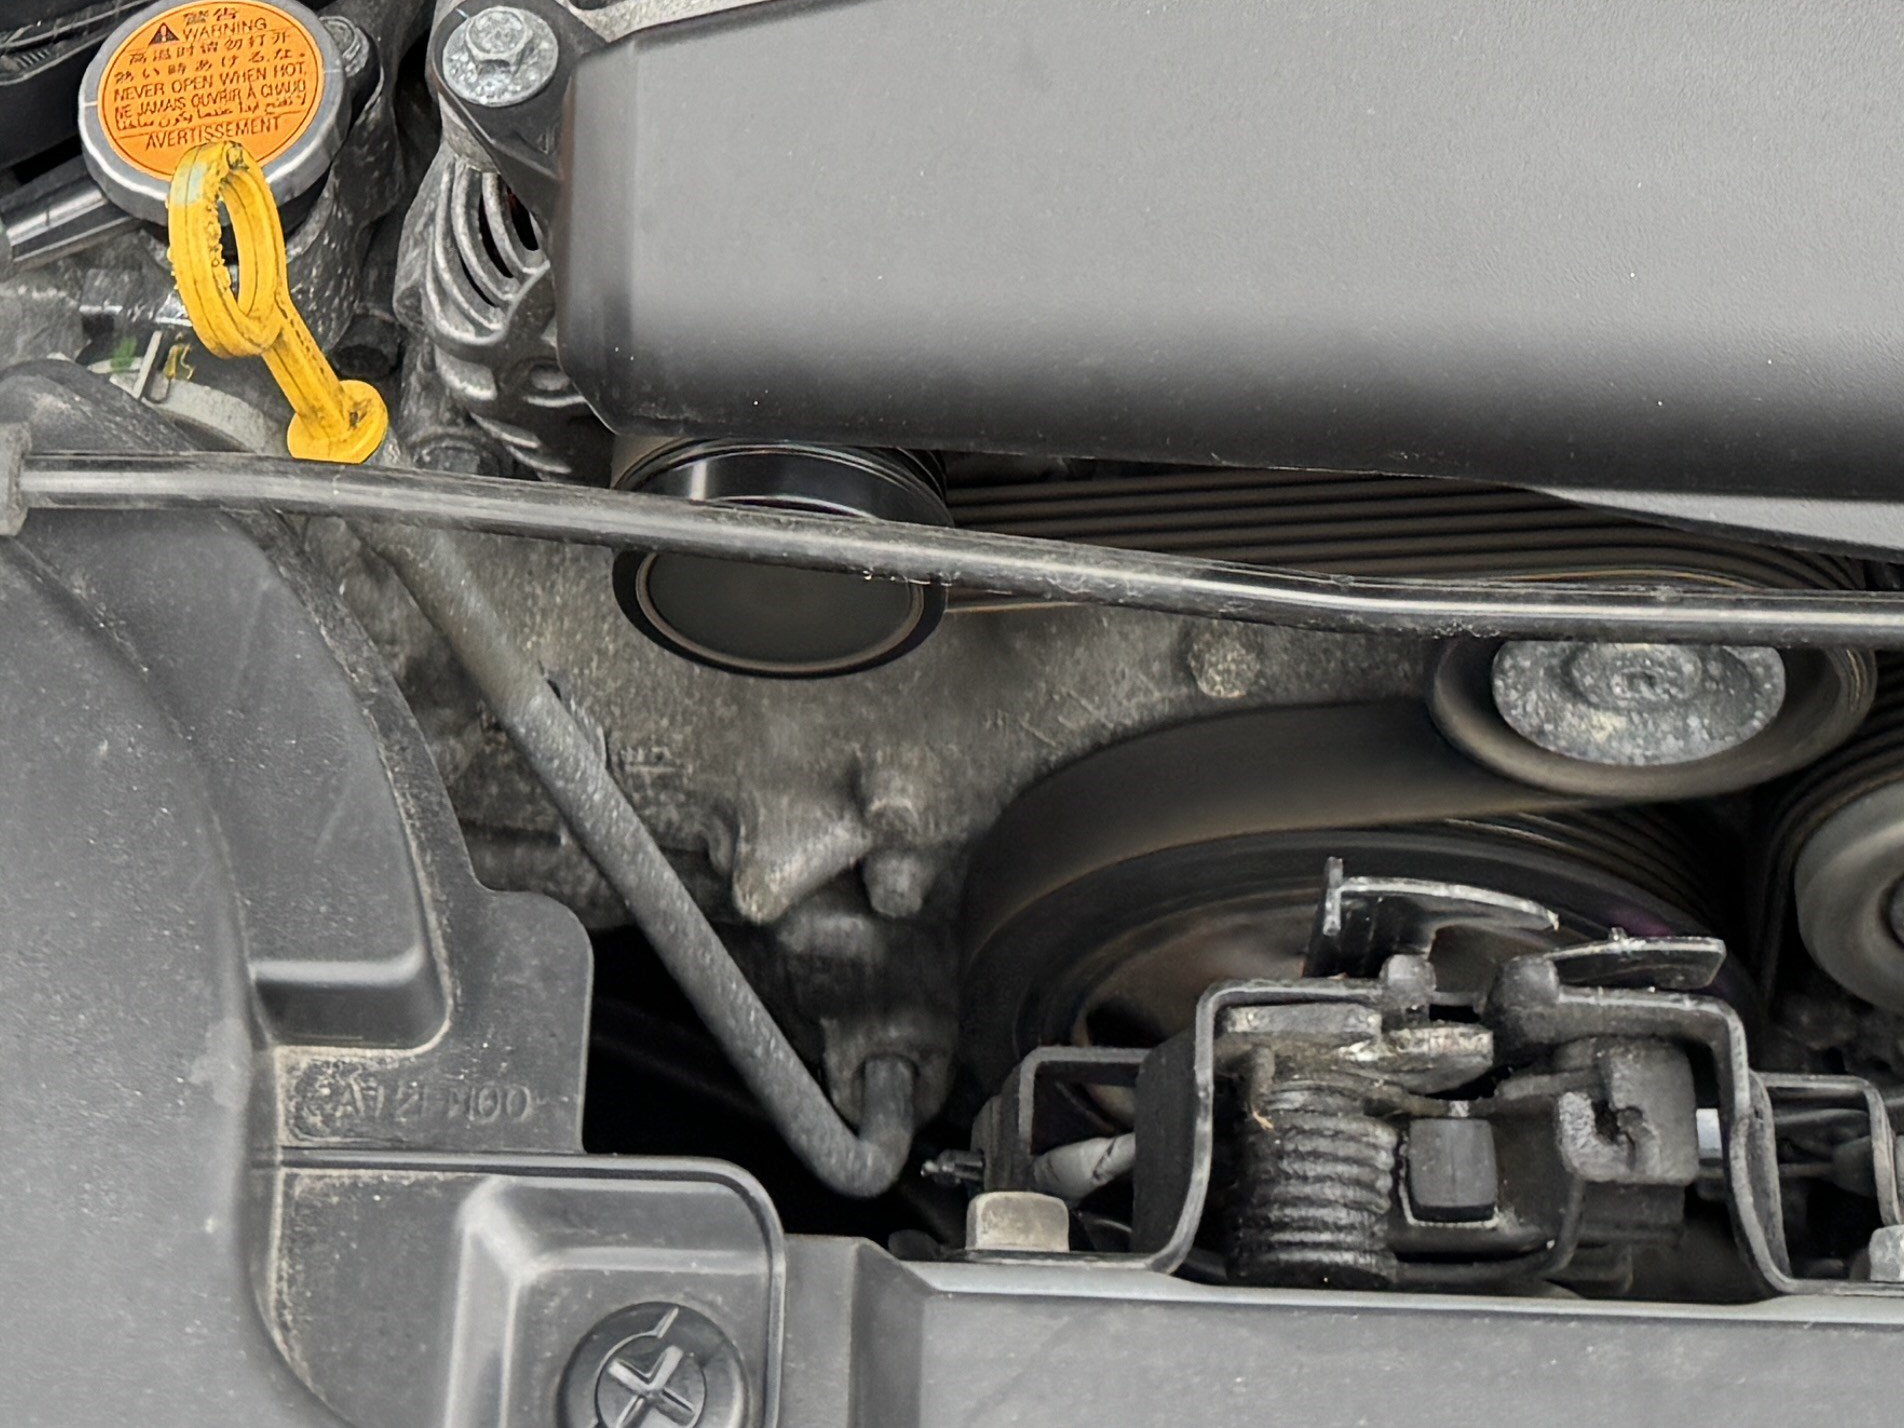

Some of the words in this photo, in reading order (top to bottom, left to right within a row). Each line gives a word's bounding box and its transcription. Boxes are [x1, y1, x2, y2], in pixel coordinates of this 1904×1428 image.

[182, 17, 267, 42] WARNING
[113, 82, 164, 103] NEVER
[171, 74, 213, 94] OPEN
[219, 66, 267, 86] WHEN
[114, 104, 130, 121] NE
[136, 97, 186, 116] JAMAIS
[191, 87, 241, 108] OUVRIR
[260, 78, 307, 98] CHAUD
[145, 116, 280, 150] AVERTISSEMENT
